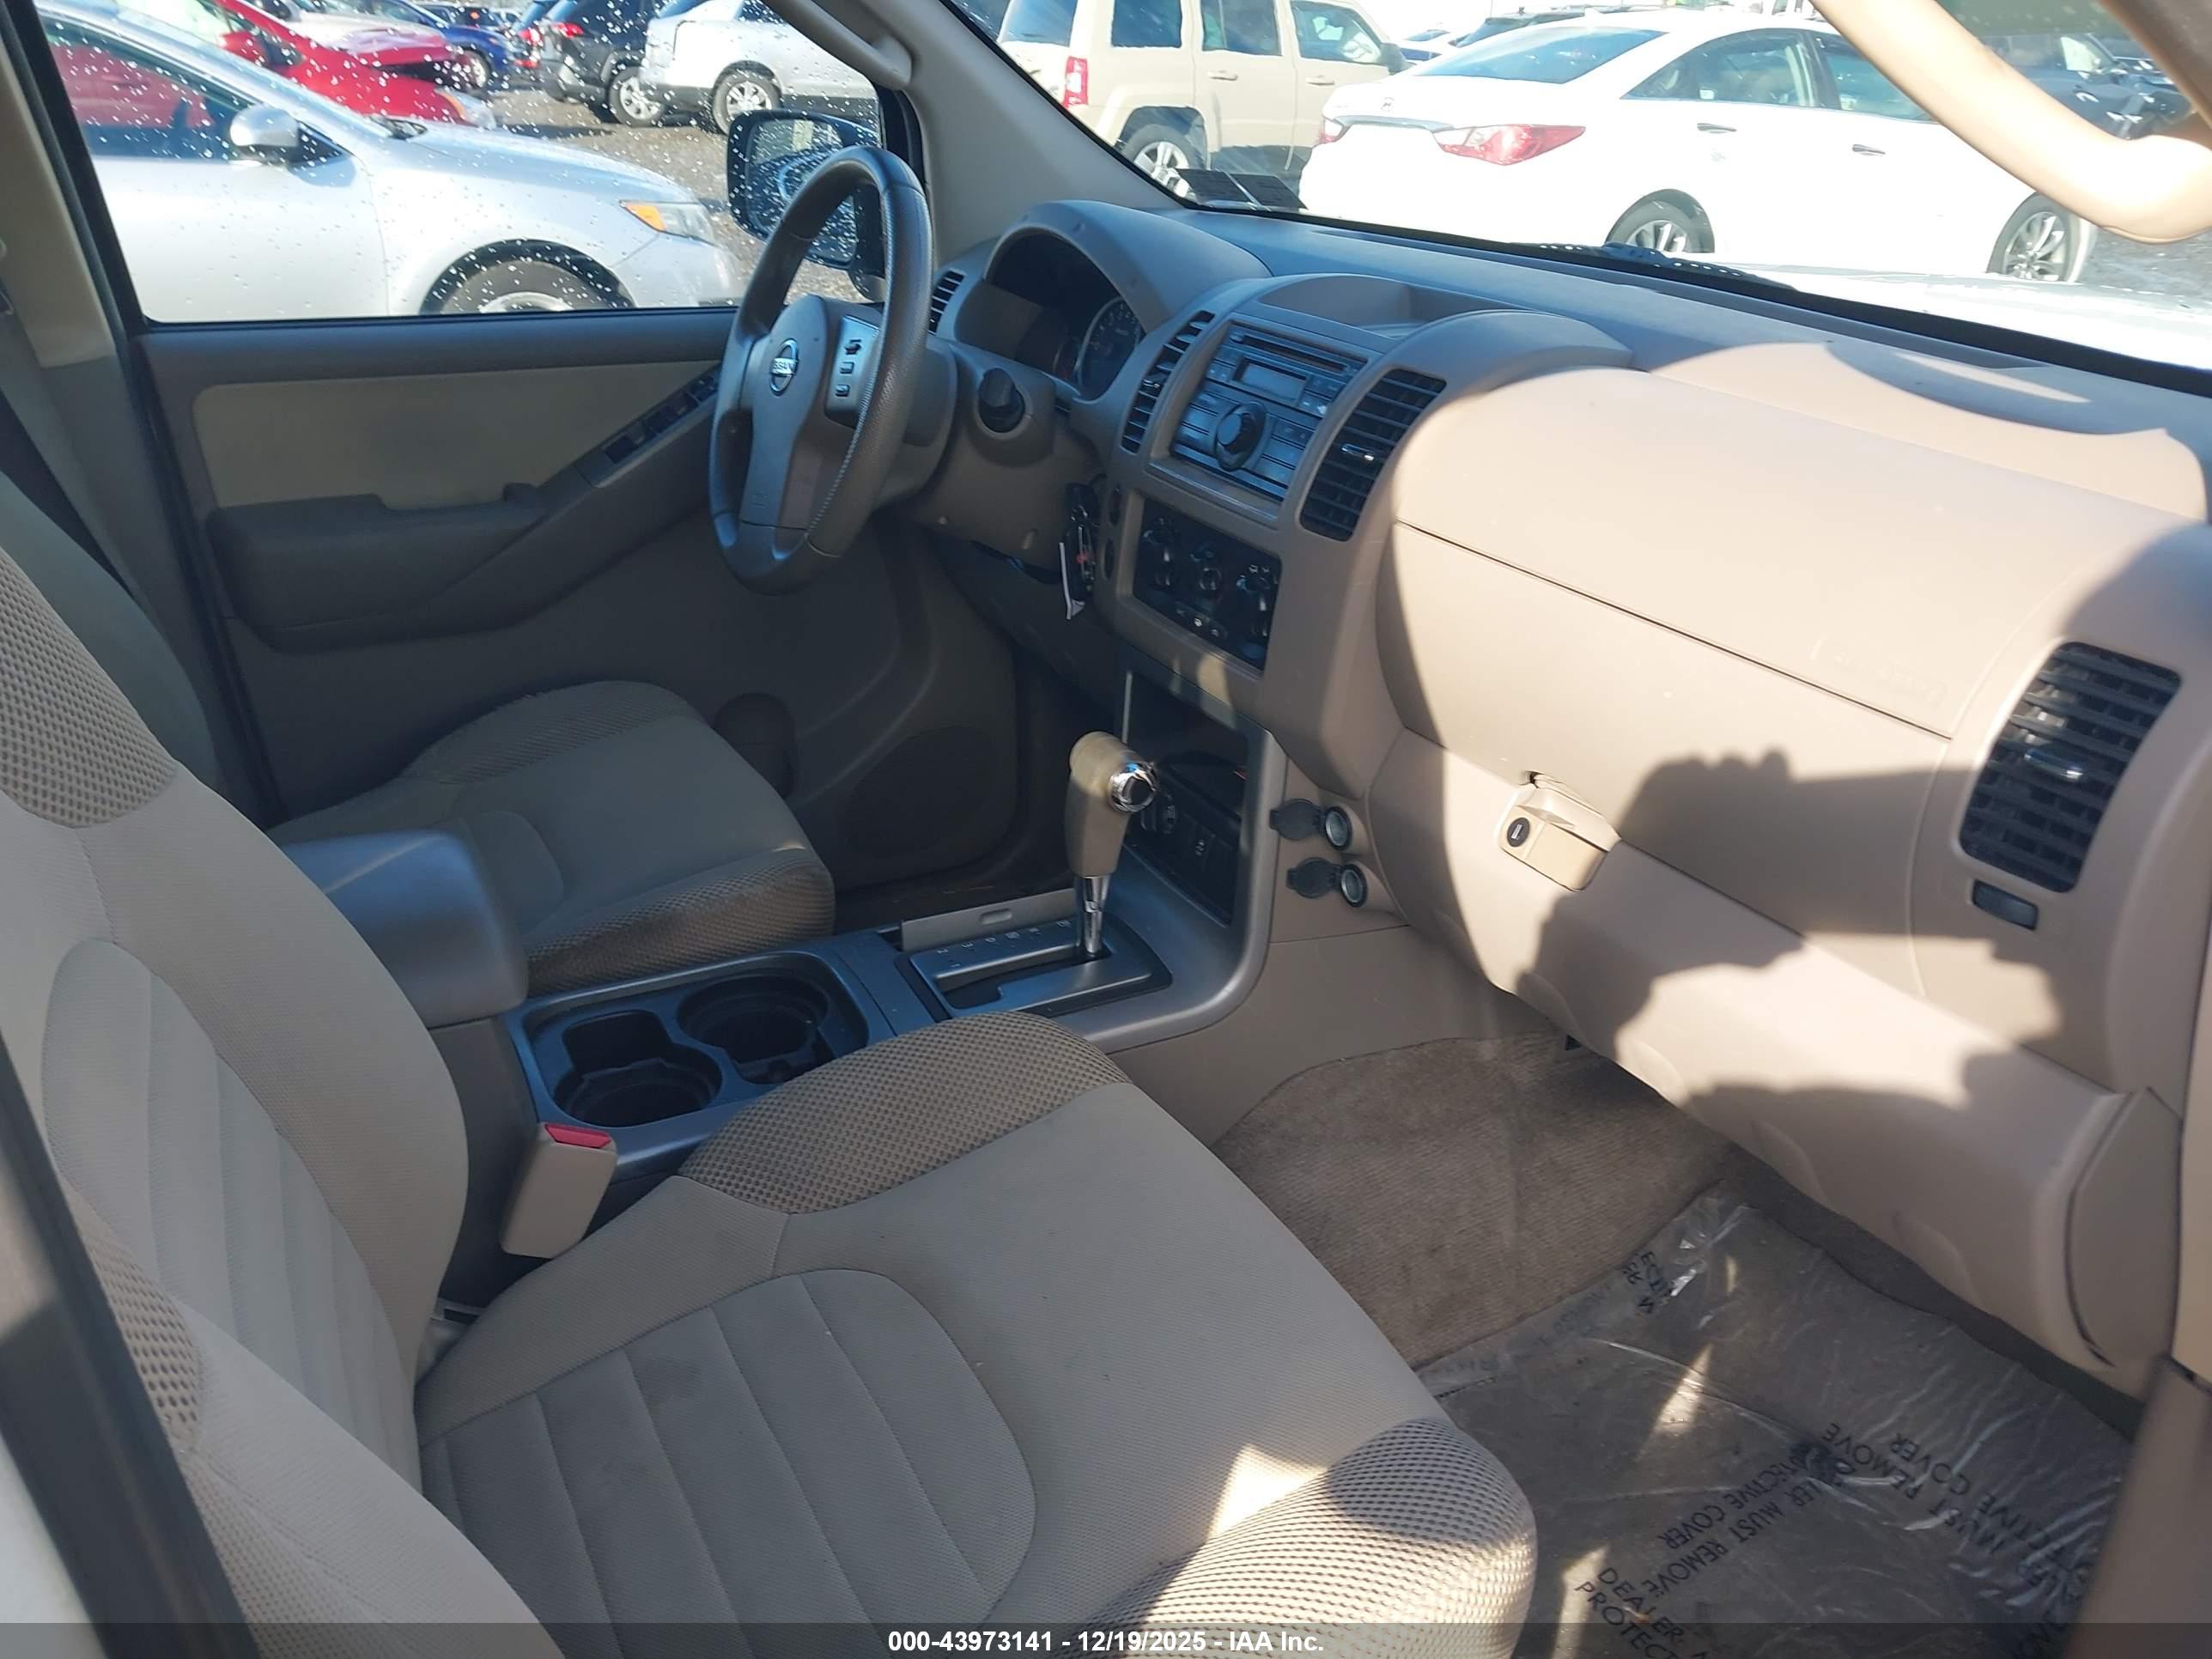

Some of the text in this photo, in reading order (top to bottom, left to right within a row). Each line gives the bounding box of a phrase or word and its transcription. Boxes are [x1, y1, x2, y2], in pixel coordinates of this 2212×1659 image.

[1821, 1422, 1923, 1501] REMOVE
[1890, 1432, 1972, 1497] COVER
[1658, 1504, 1726, 1550] COVER
[1729, 1500, 1787, 1544] MUST
[1641, 1538, 1729, 1597] REMOVE
